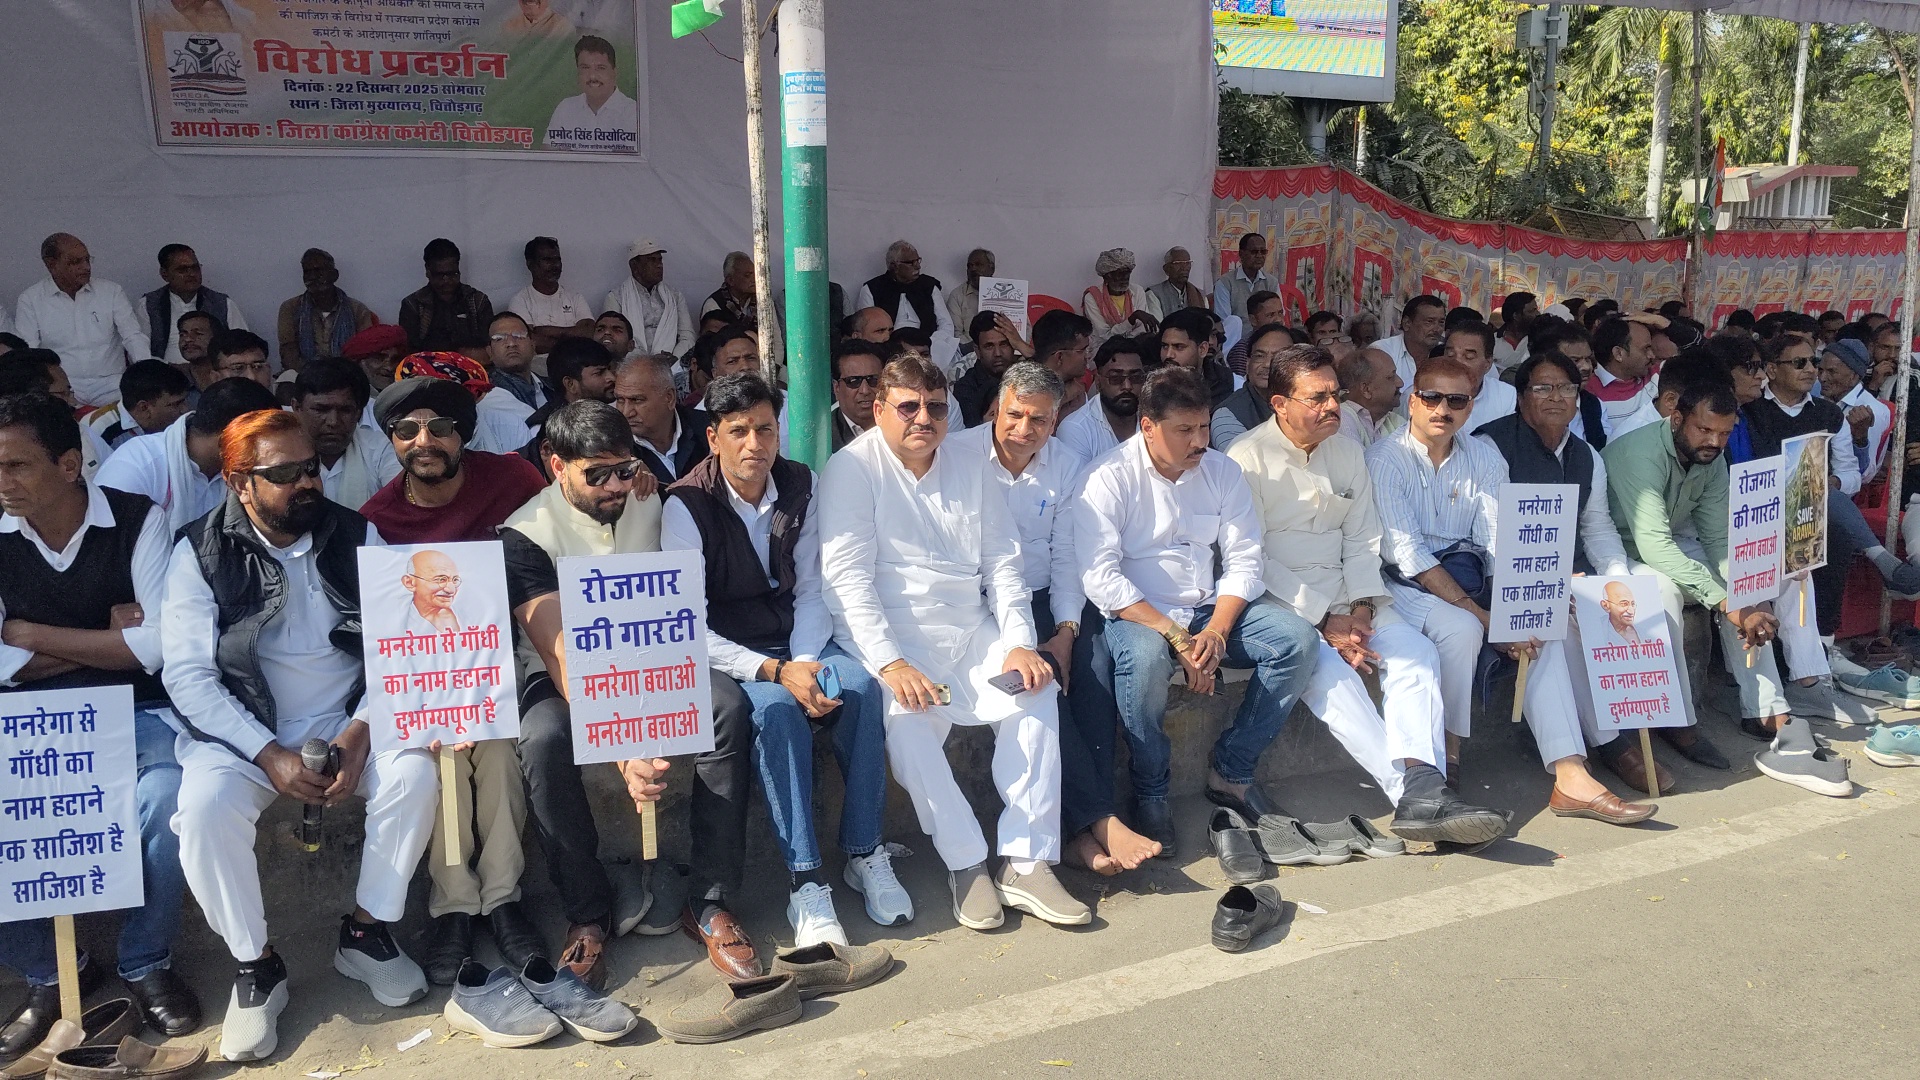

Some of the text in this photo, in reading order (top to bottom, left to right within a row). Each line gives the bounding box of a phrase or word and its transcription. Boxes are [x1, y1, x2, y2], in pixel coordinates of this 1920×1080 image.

[279, 8, 480, 27] की साजिश के विरोध में राजस्थान प्रदेश कांग्रेस
[311, 26, 451, 43] कमेटी के आदेशानुसार शांतिपूर्ण
[253, 39, 508, 79] विरोध प्रदर्शन
[283, 79, 325, 93] दिनांक
[336, 83, 354, 93] 22
[356, 81, 401, 94] दिसम्बर
[404, 84, 439, 94] 2025
[441, 82, 486, 95] सोमवार
[289, 99, 320, 109] स्थान
[330, 97, 364, 110] जिला
[429, 98, 484, 115] चित्तौड़गढ़
[170, 117, 260, 138] आयोजक
[277, 119, 330, 140] जिला
[333, 119, 391, 141] कांग्रेस
[393, 120, 449, 142] कमेटी
[548, 127, 636, 142] प्रमोद सिंह सिसोदिया
[1739, 469, 1777, 495] रोजगार
[1518, 494, 1563, 515] मनरेगा से
[1733, 496, 1780, 530] की गारंटी
[1797, 506, 1813, 525] SAVE
[1544, 527, 1559, 543] का
[1735, 530, 1777, 564] मनरेगा बचाओ
[1512, 551, 1560, 573] नाम हटाने
[579, 569, 682, 603] रोजगार
[1502, 577, 1565, 602] एक साजिश है
[1733, 563, 1776, 598] मनरेगा बचाओ
[572, 608, 697, 652] की गारंटी
[1510, 607, 1553, 631] साजिश है
[377, 624, 500, 658] मनरेगा से गाँधी
[1592, 641, 1629, 663] मनरेगा
[1629, 640, 1640, 660] से
[383, 666, 501, 695] का नाम हटाना
[582, 655, 697, 700] मनरेगा बचाओ
[1598, 670, 1670, 691] का नाम हटाना
[482, 696, 496, 724] है
[1661, 692, 1670, 714] है
[1, 703, 97, 738] मनरेगा से
[585, 702, 699, 748] मनरेगा बचाओ
[8, 747, 94, 779] गाँधी का
[2, 785, 105, 821] नाम हटाने
[31, 828, 105, 861] साजिश
[107, 822, 124, 852] है
[12, 865, 106, 903] साजिश है
